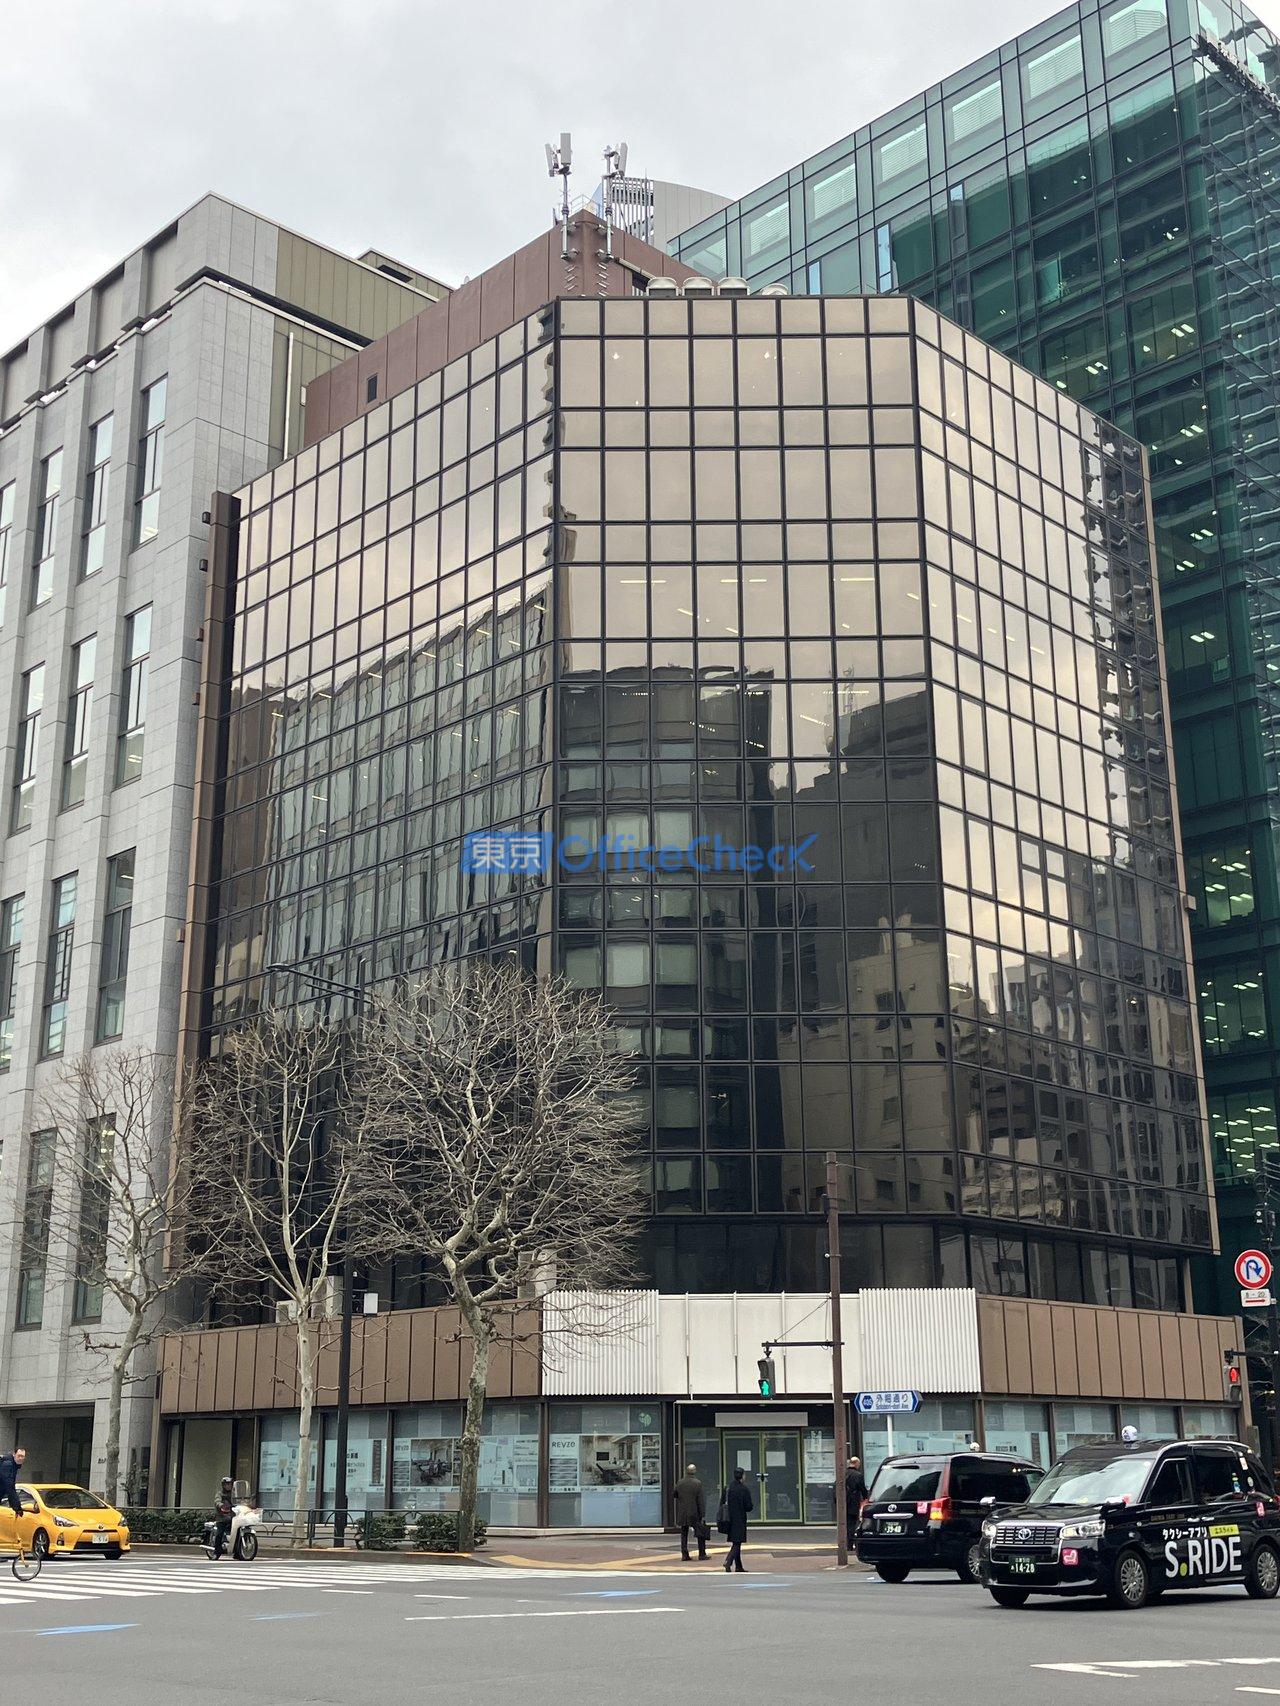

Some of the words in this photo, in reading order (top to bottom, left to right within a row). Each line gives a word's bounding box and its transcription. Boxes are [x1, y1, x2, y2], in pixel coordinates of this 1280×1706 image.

[1162, 1526, 1208, 1540] タクシーアプリ
[1164, 1536, 1242, 1578] S.RIDE
